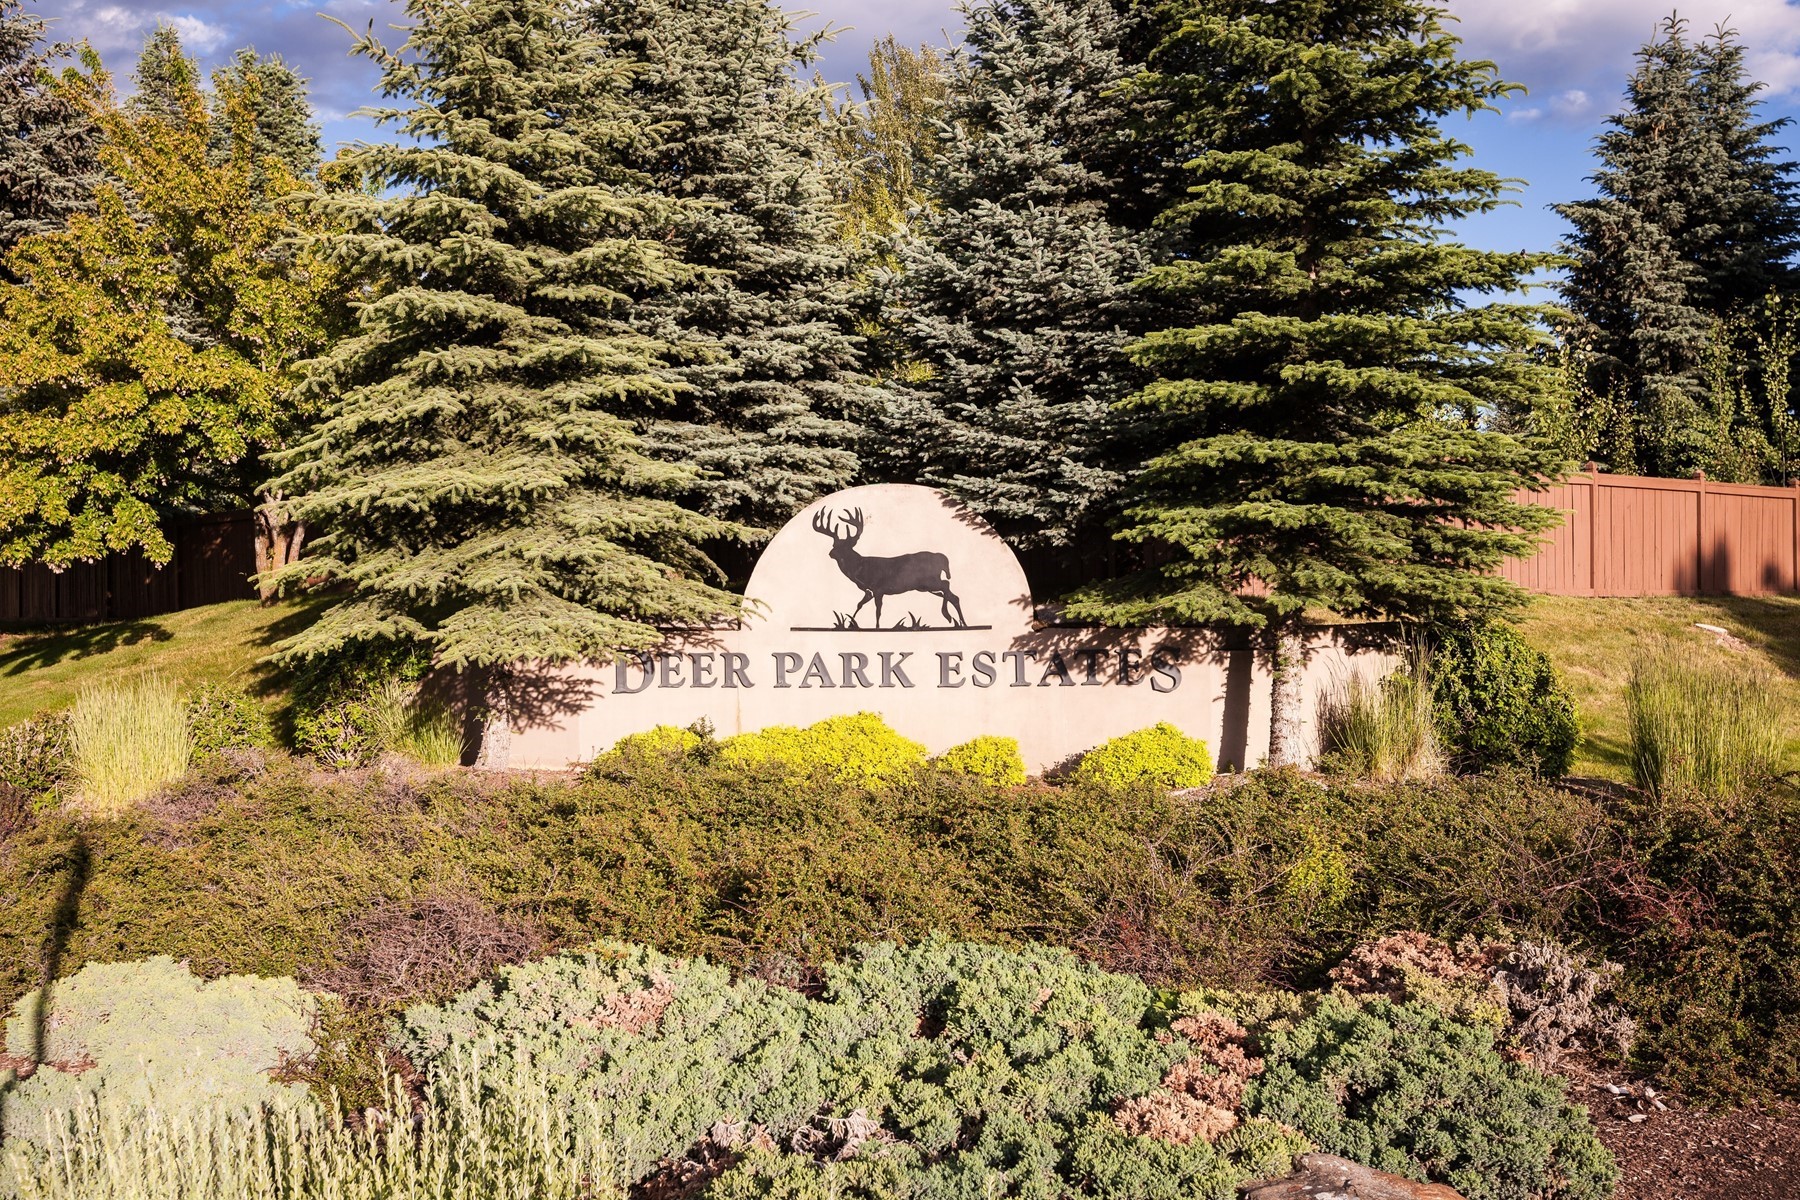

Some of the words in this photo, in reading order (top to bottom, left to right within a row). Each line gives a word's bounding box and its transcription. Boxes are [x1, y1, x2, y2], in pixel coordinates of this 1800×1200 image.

[611, 650, 756, 694] DEER
[771, 651, 916, 688] PARK
[935, 646, 1183, 694] ESTATES
